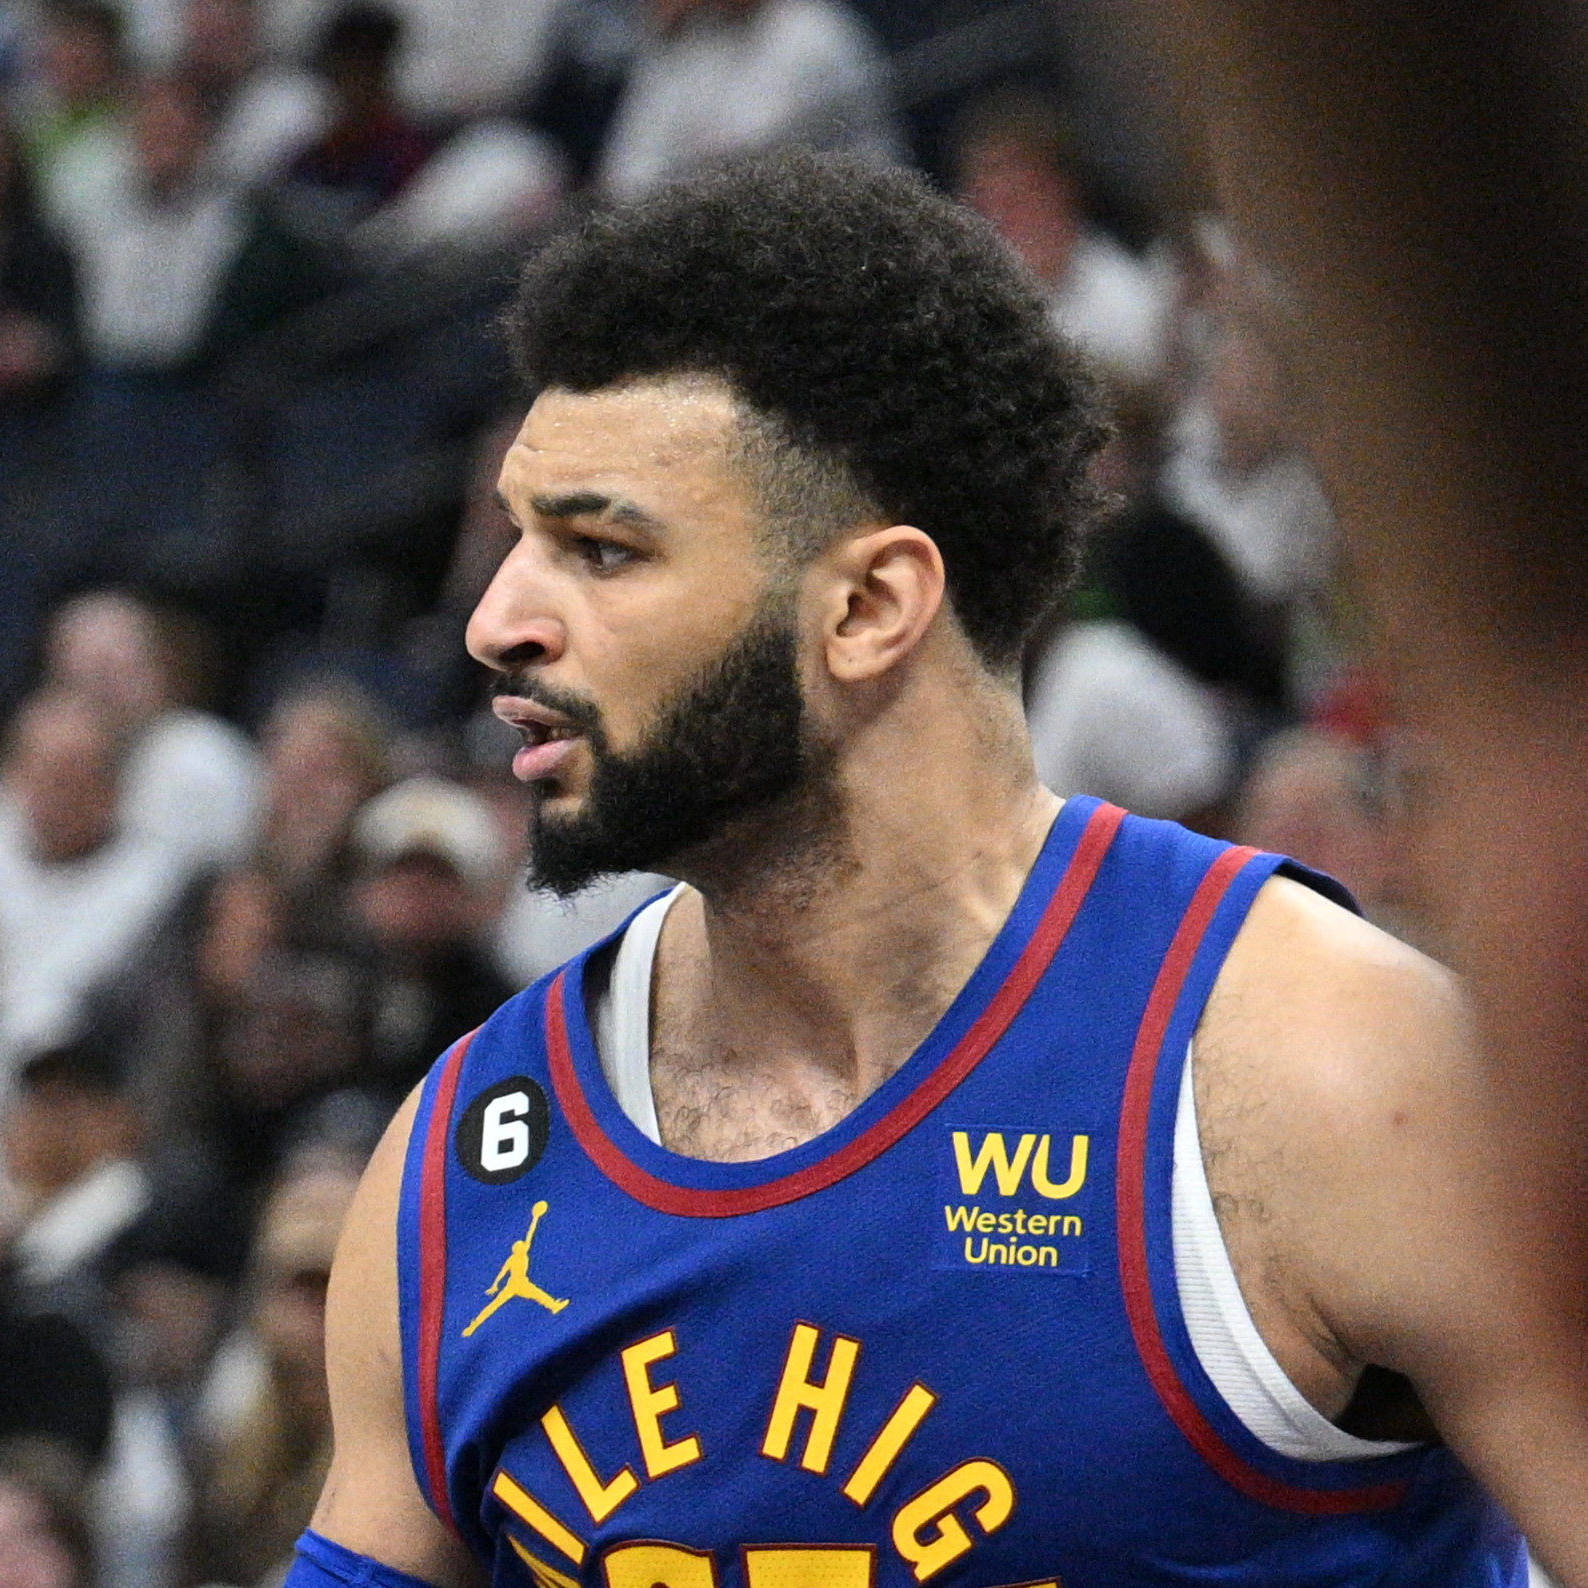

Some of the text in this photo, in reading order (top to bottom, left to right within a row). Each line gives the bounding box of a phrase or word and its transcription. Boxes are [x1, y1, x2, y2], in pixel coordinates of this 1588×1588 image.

[479, 1089, 531, 1172] 6
[952, 1131, 1090, 1200] WU
[944, 1205, 1083, 1237] Western
[964, 1236, 1059, 1268] Union
